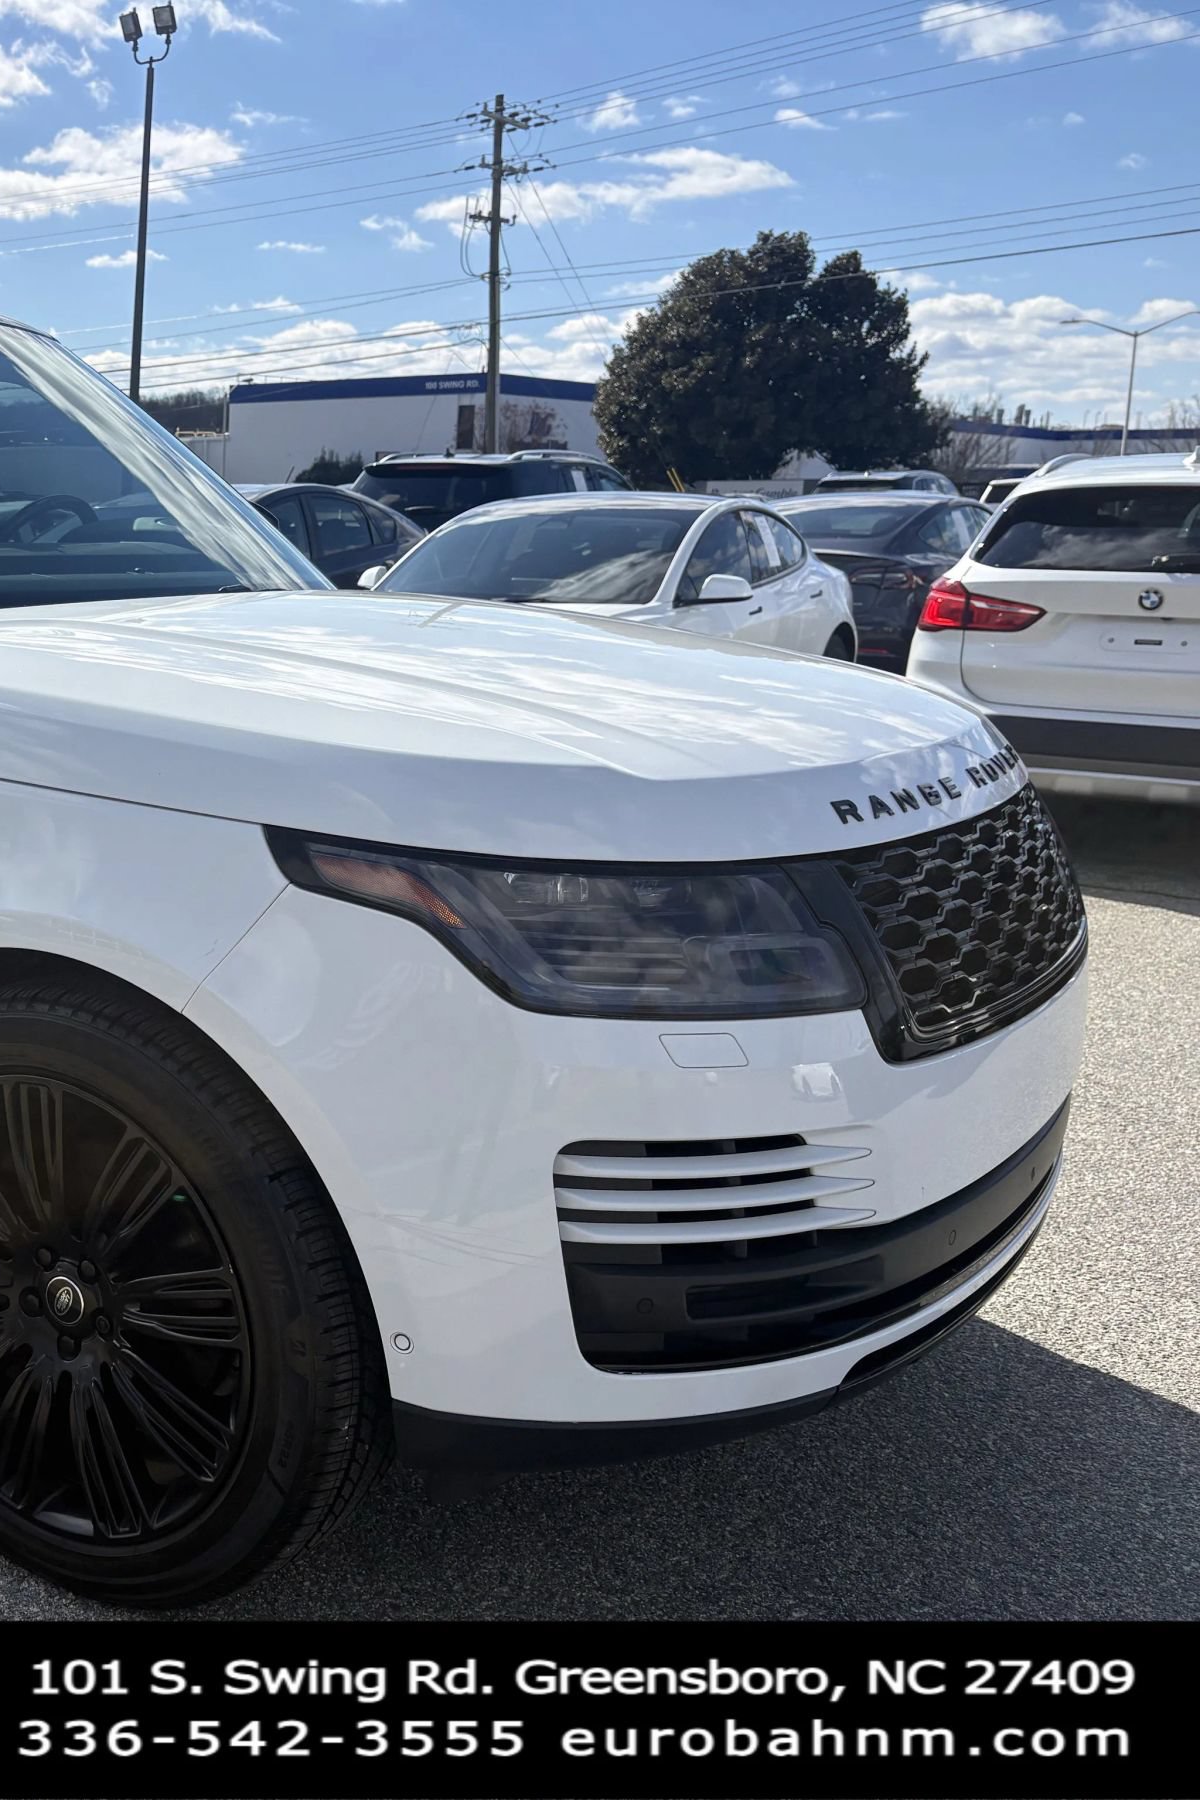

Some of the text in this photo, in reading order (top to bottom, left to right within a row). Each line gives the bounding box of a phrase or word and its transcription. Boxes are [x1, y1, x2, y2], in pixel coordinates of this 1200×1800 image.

[439, 380, 465, 390] SWING
[830, 744, 1020, 824] RANGE ROVER
